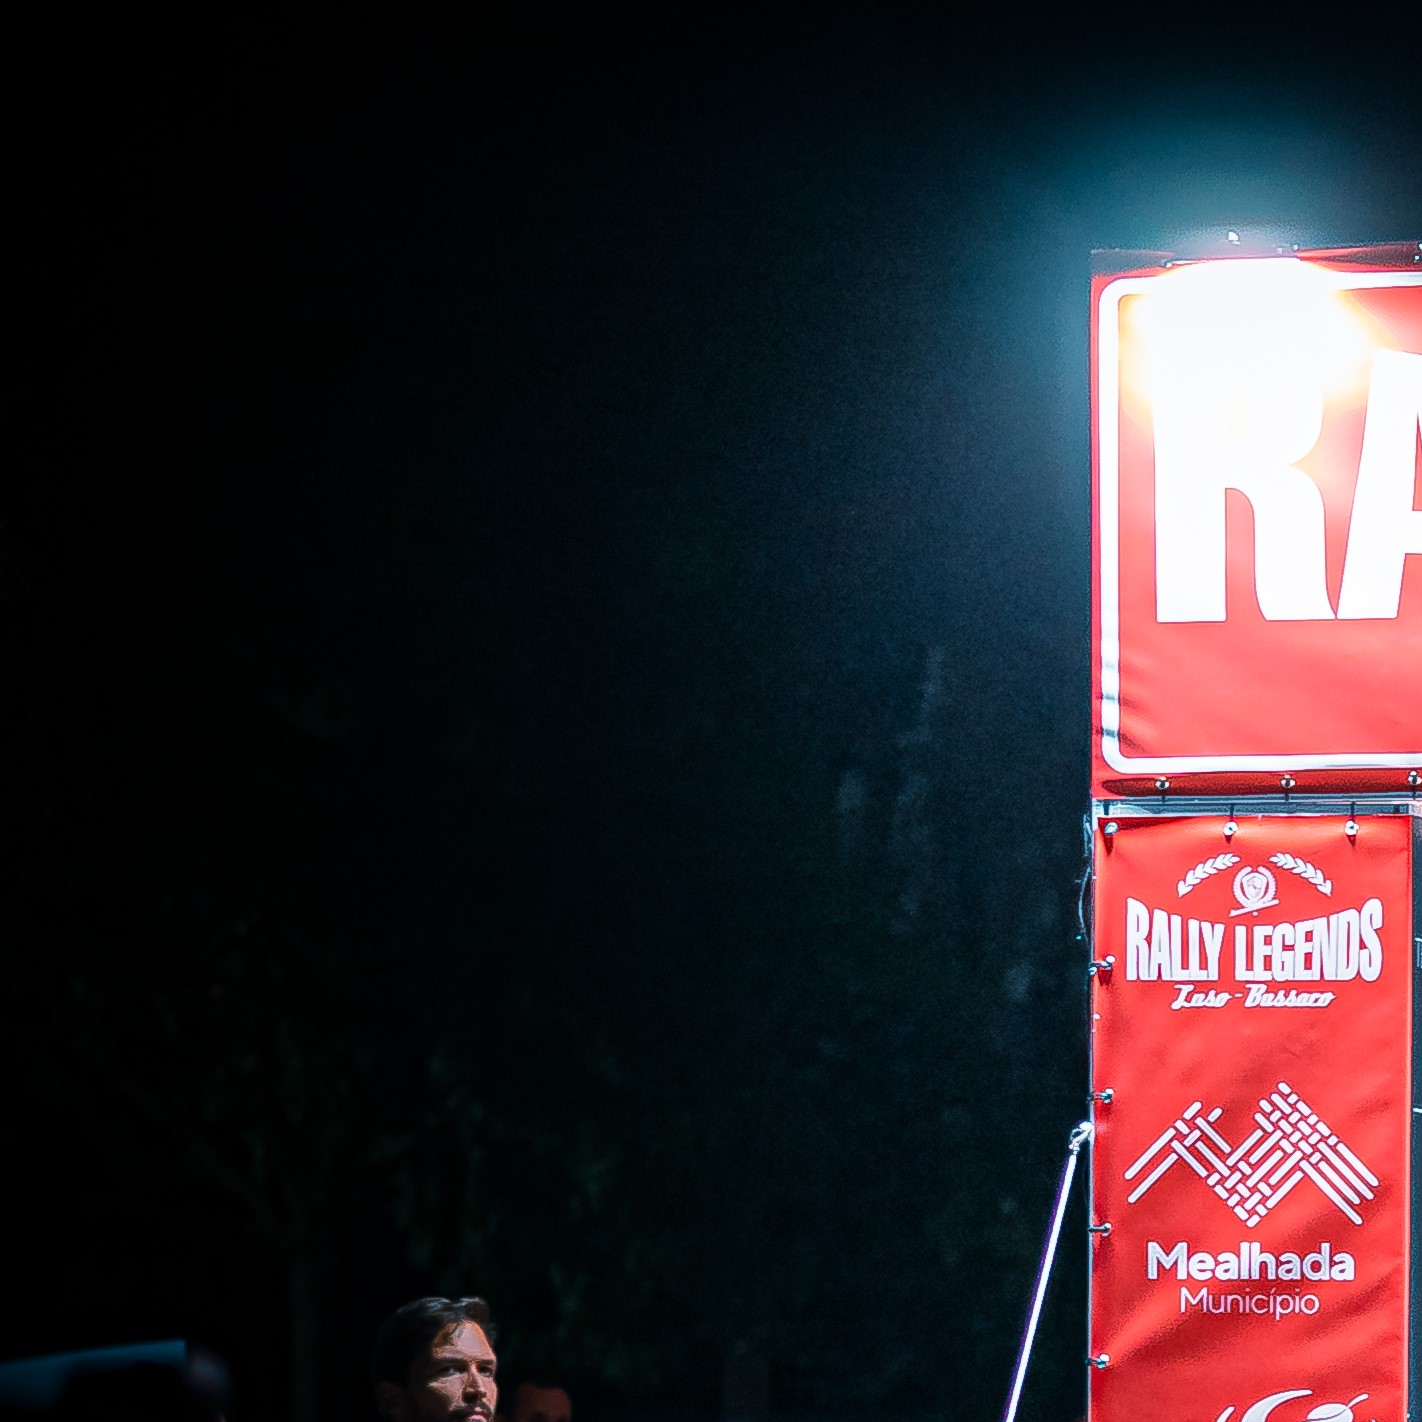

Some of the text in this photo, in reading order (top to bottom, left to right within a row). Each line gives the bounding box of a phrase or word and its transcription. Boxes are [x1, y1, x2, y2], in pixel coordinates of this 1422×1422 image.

[1126, 898, 1384, 982] RALLY LEGENDS
[1171, 984, 1231, 1009] Luso
[1244, 984, 1336, 1008] Bussaco
[1147, 1242, 1355, 1281] Mealhada
[1180, 1287, 1320, 1319] Município
